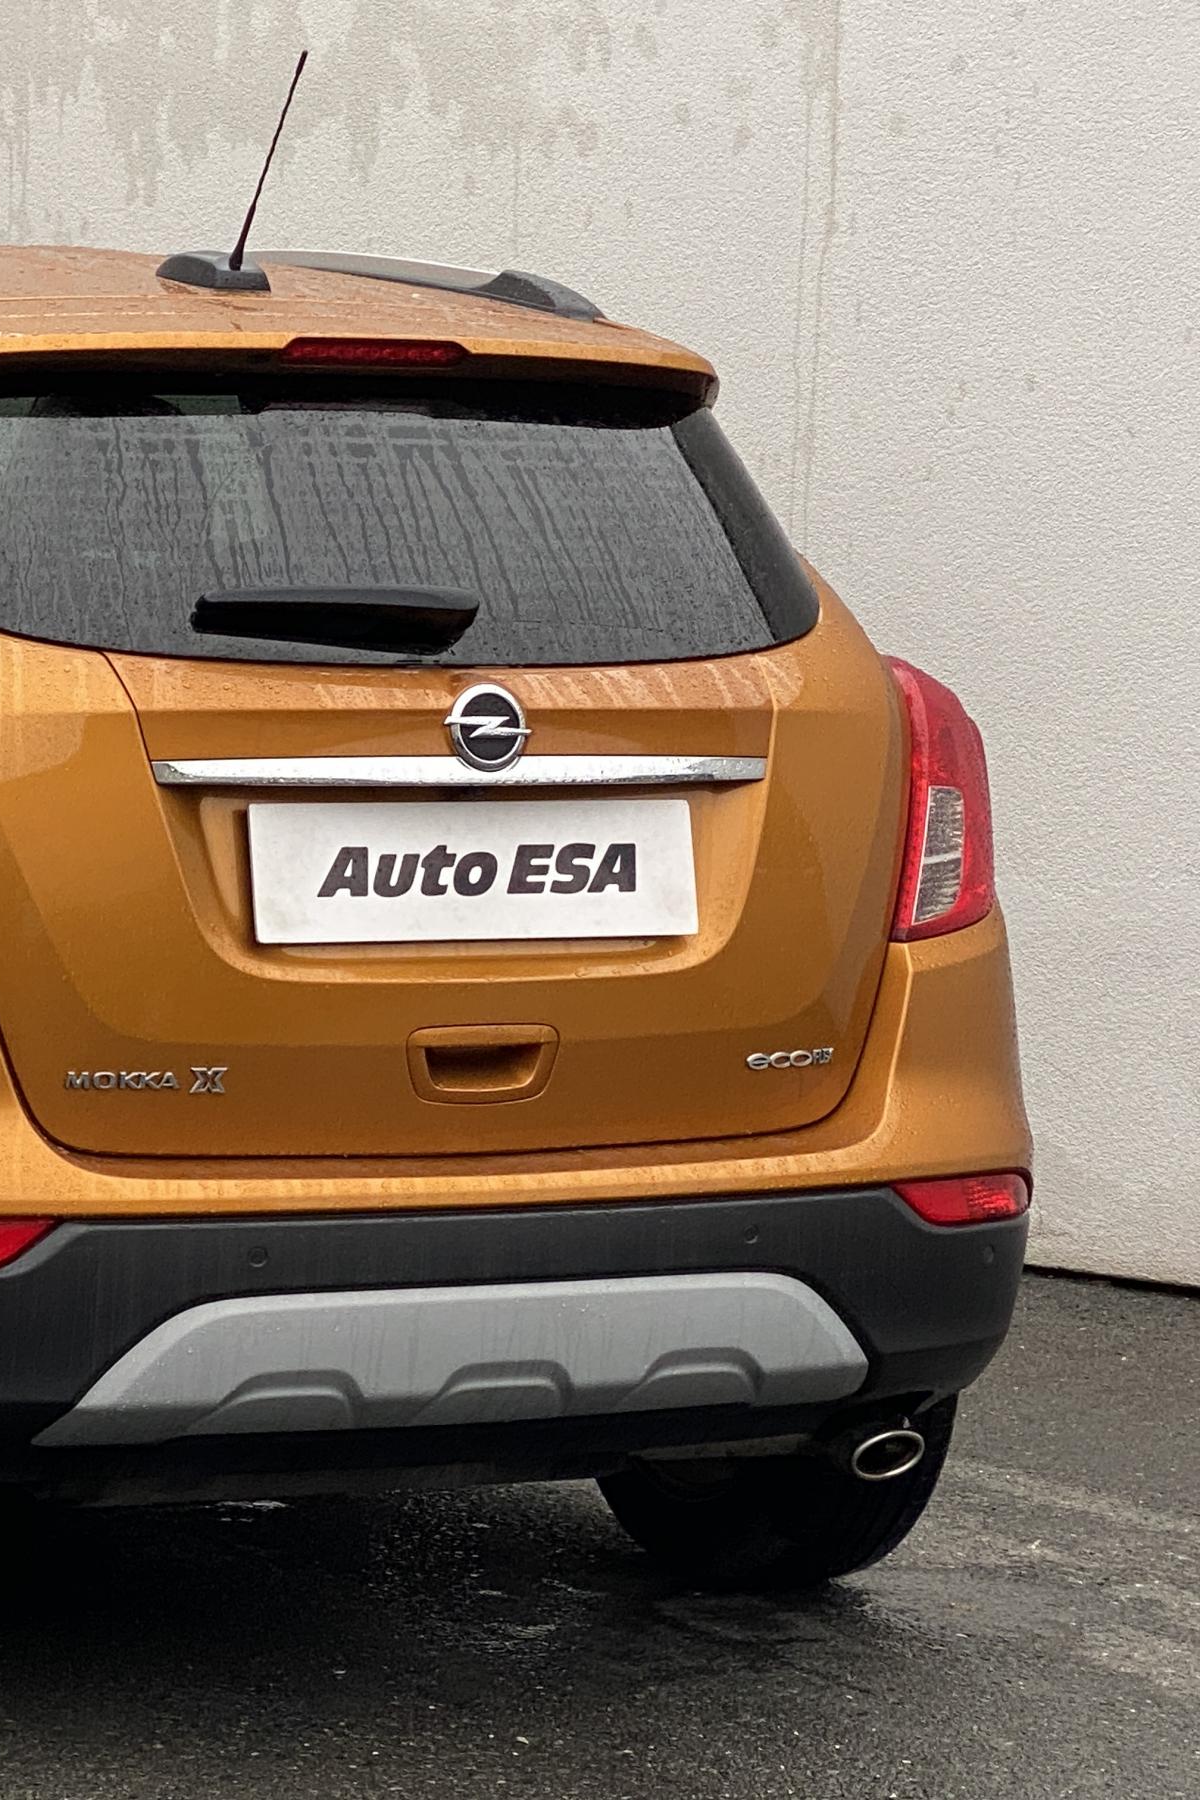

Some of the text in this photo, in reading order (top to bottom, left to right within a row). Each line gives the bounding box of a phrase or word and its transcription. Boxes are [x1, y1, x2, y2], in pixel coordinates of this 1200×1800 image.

[317, 842, 637, 898] Auto ESA
[65, 1066, 229, 1094] MOKKA X
